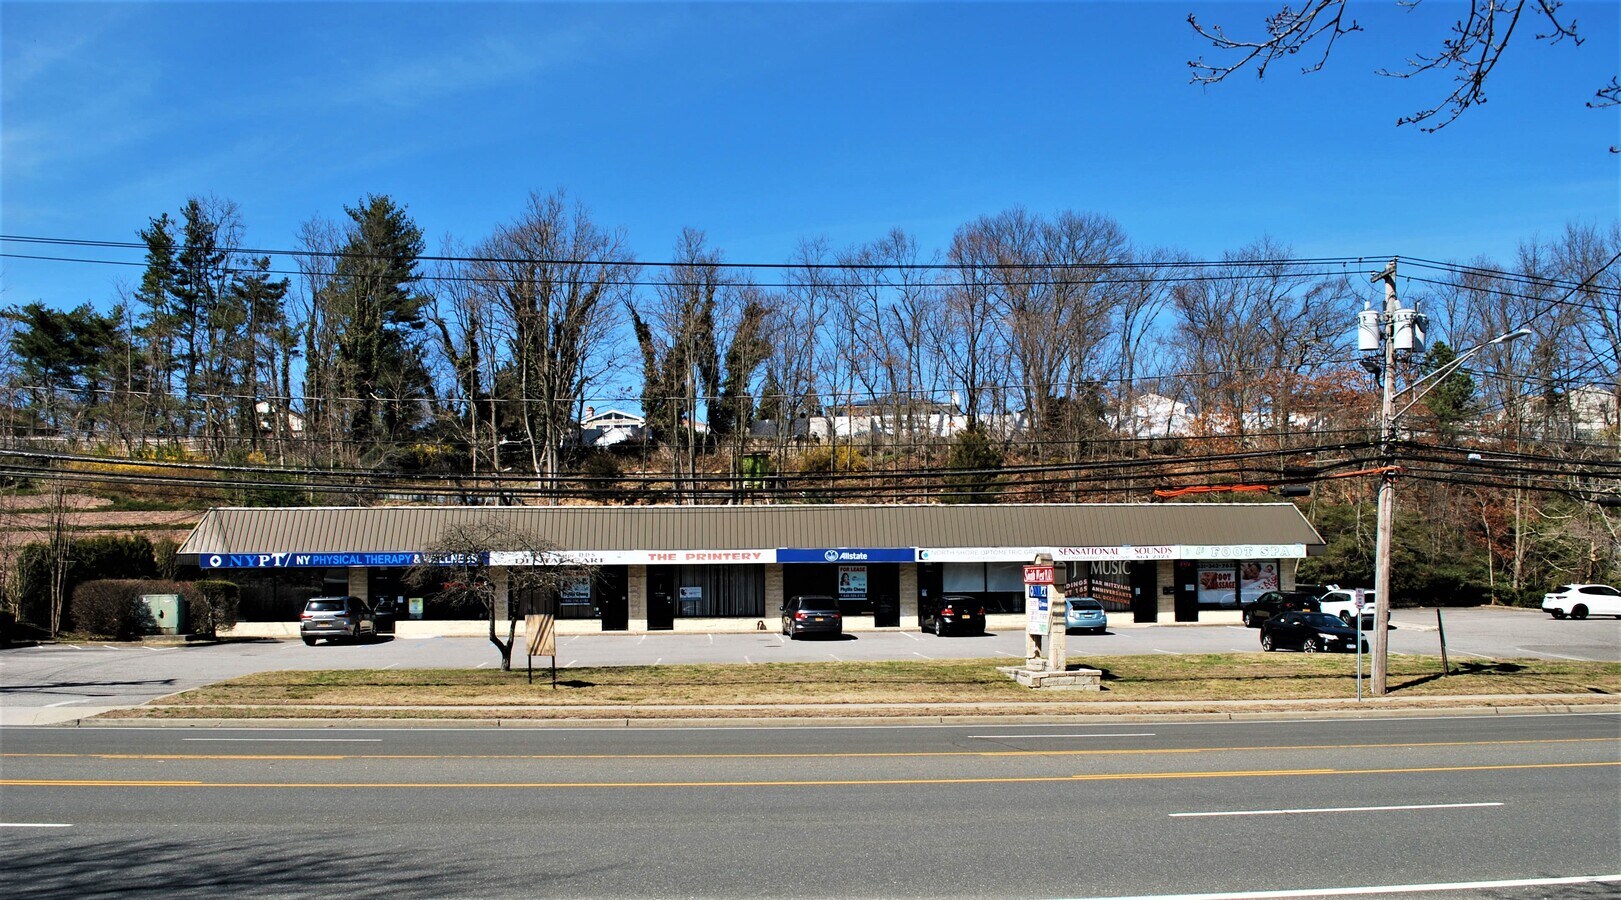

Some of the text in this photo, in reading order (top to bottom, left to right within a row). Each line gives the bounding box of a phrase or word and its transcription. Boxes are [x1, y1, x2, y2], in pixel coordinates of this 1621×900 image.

[648, 552, 762, 561] THE PRINTERY
[839, 552, 868, 560] Allstate
[1058, 547, 1172, 556] SENSATIONAL SOUNDS
[1210, 546, 1253, 557] FOOT
[1260, 545, 1290, 556] SPA
[296, 553, 478, 565] NY PHYSICAL THERAPY & WLLNESS
[1090, 560, 1132, 575] MUSIC
[1063, 578, 1088, 591] DINGS
